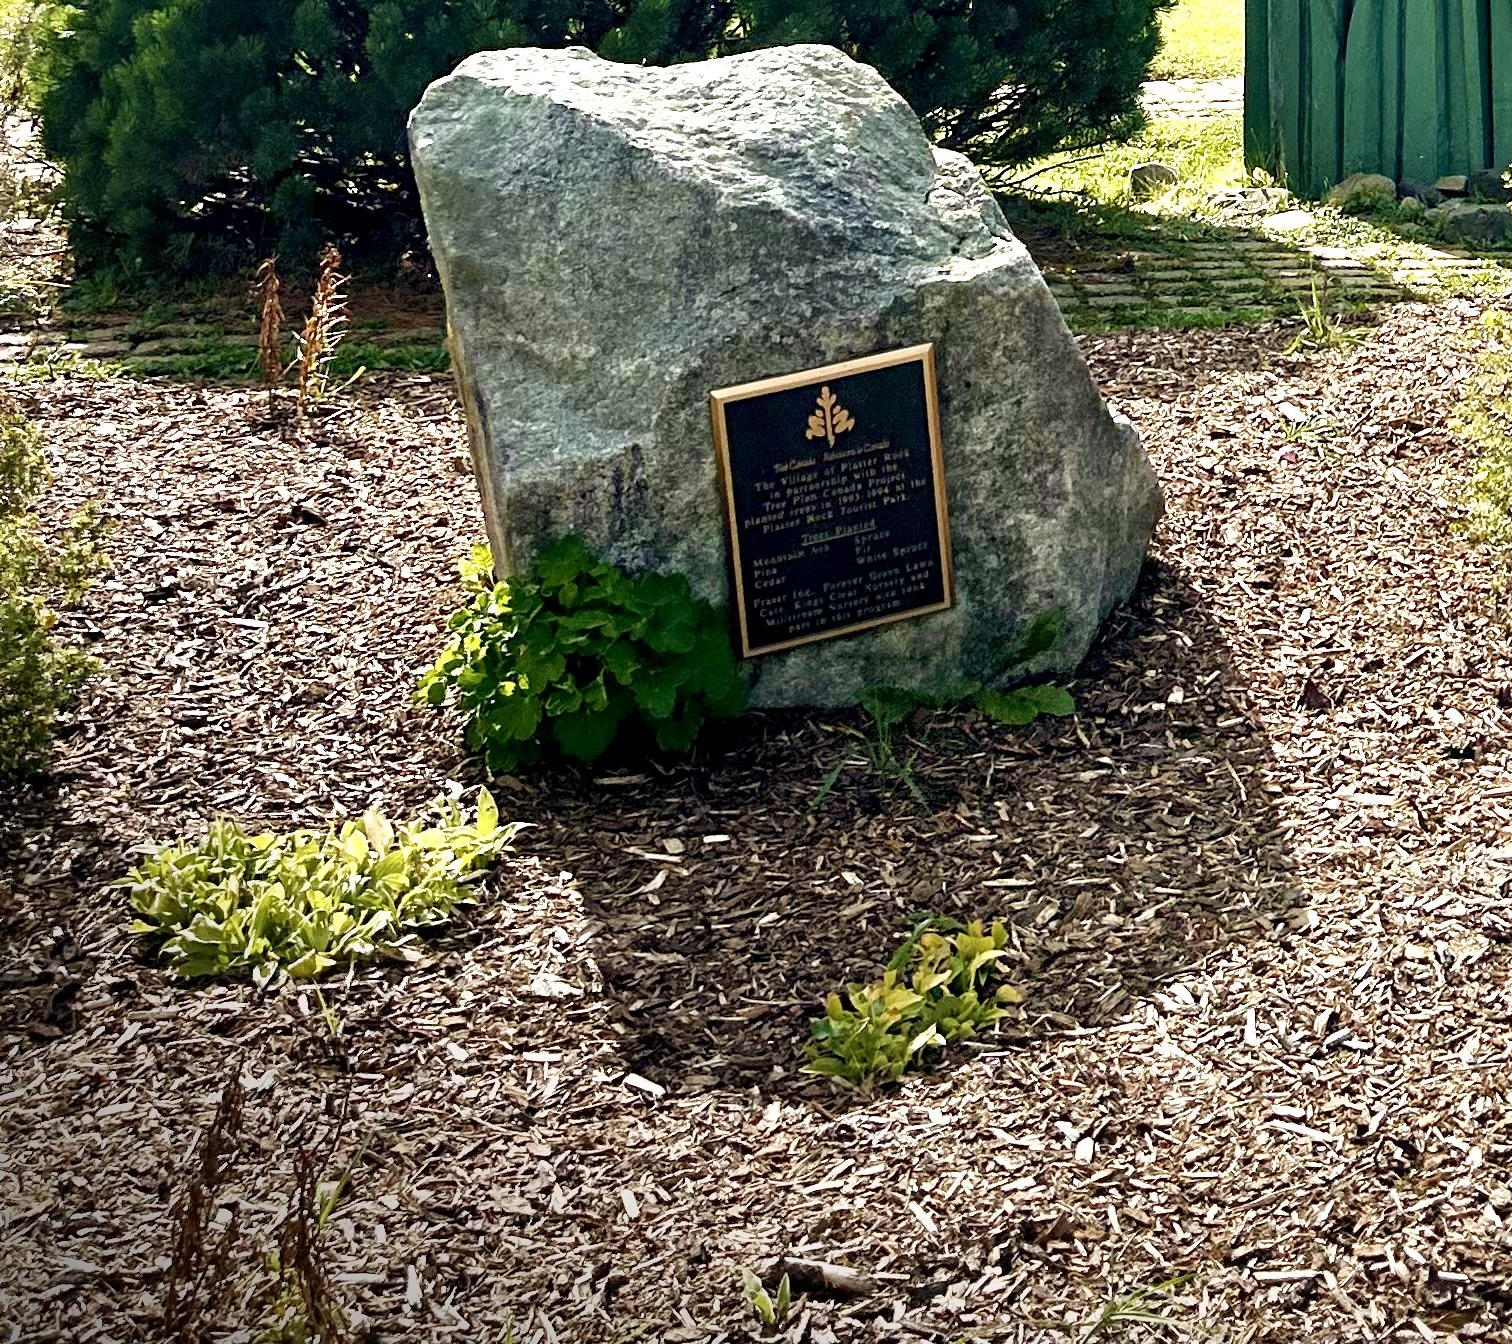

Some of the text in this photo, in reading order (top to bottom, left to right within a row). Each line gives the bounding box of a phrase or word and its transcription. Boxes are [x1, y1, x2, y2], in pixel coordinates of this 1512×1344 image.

[755, 482, 775, 492] The
[781, 472, 818, 485] Village
[824, 466, 835, 476] of
[841, 458, 877, 472] Plaster
[884, 449, 909, 461] Rock
[770, 464, 897, 499] in partnership with the
[911, 479, 926, 488] the
[763, 473, 905, 511] Tree Plan Canada Project
[763, 519, 800, 534] Plaster
[807, 511, 833, 523] Rock
[841, 502, 876, 515] Tourist
[801, 518, 875, 544] Trees Planted
[855, 530, 890, 545] Spruce
[855, 546, 870, 555] Fir
[856, 541, 928, 564] White Spruce
[754, 551, 804, 567] Mountain
[906, 559, 934, 572] Lawn
[754, 568, 777, 578] Pine
[911, 570, 929, 581] and
[755, 576, 786, 589] Cedar
[829, 597, 868, 610] Nursery
[832, 613, 851, 622] this
